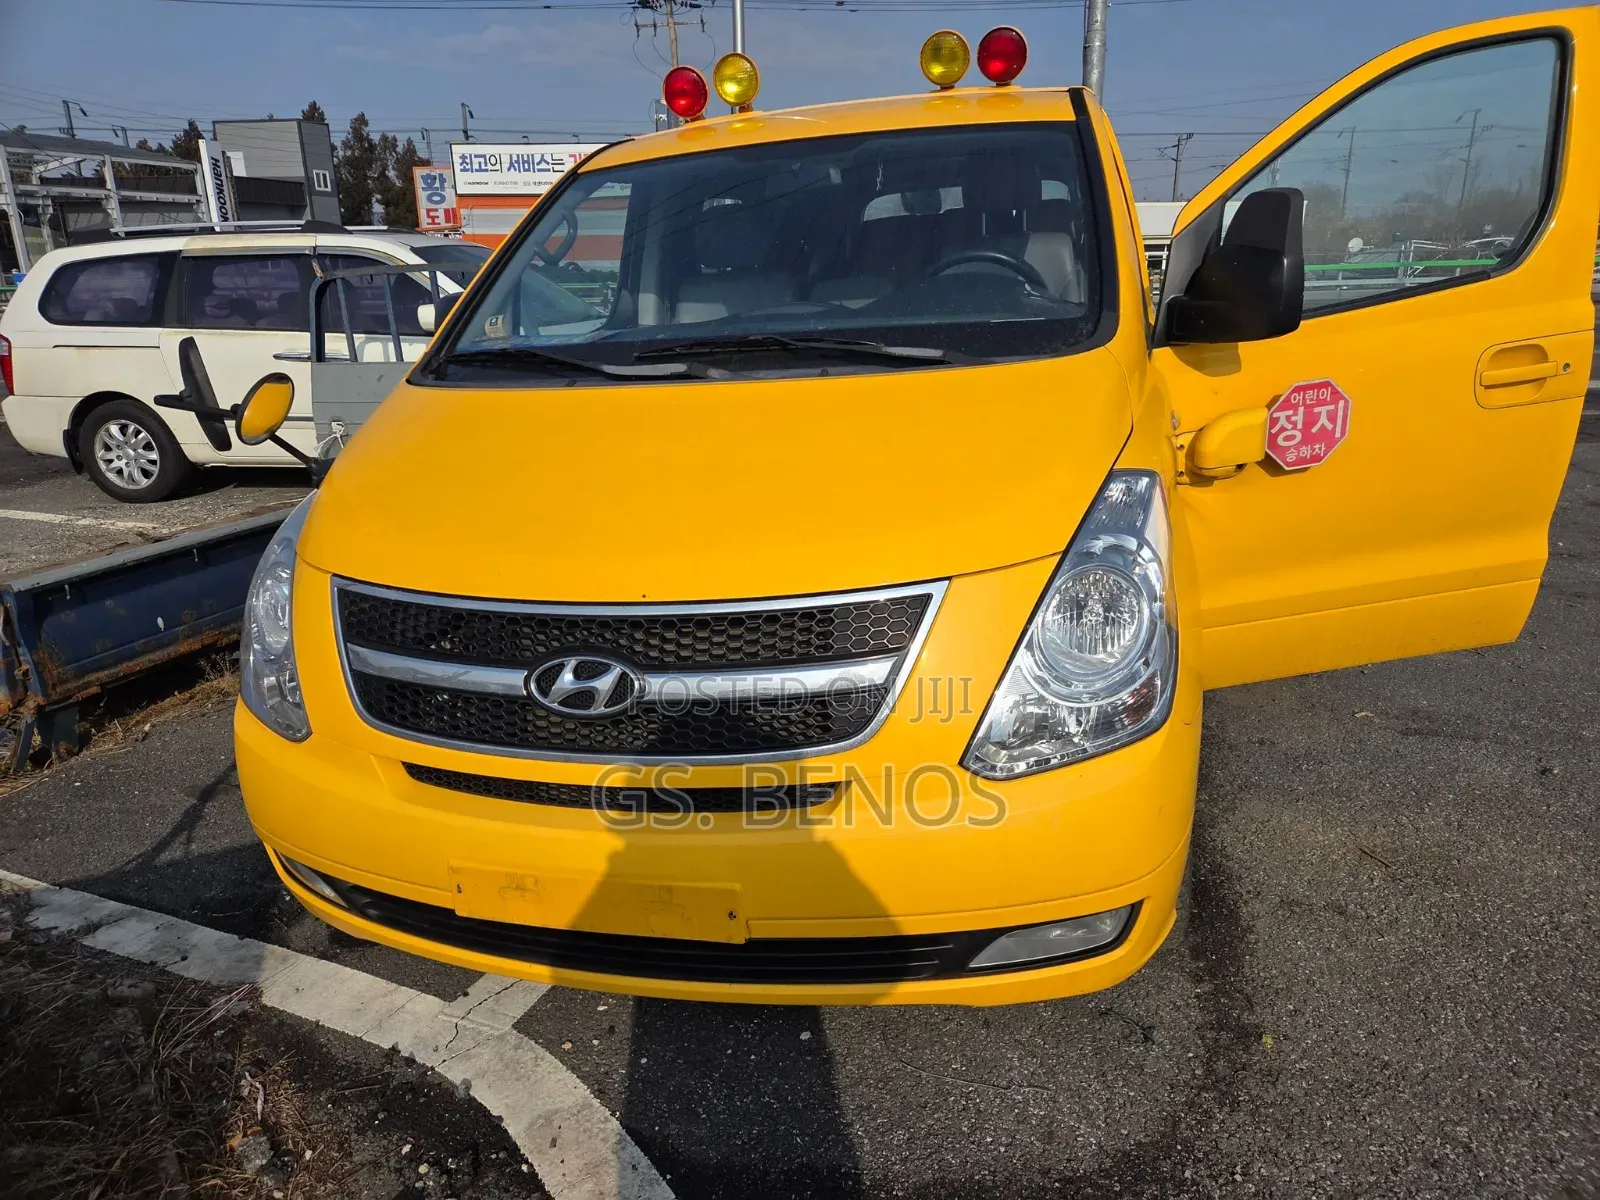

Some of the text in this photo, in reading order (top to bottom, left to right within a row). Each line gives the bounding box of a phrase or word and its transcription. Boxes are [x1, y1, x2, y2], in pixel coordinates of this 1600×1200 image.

[459, 153, 502, 173] 최고의
[507, 153, 565, 173] 서비스는
[420, 172, 447, 205] 황
[1291, 386, 1332, 406] 어린이
[1270, 399, 1345, 447] 정지
[1285, 443, 1326, 462] 승하차
